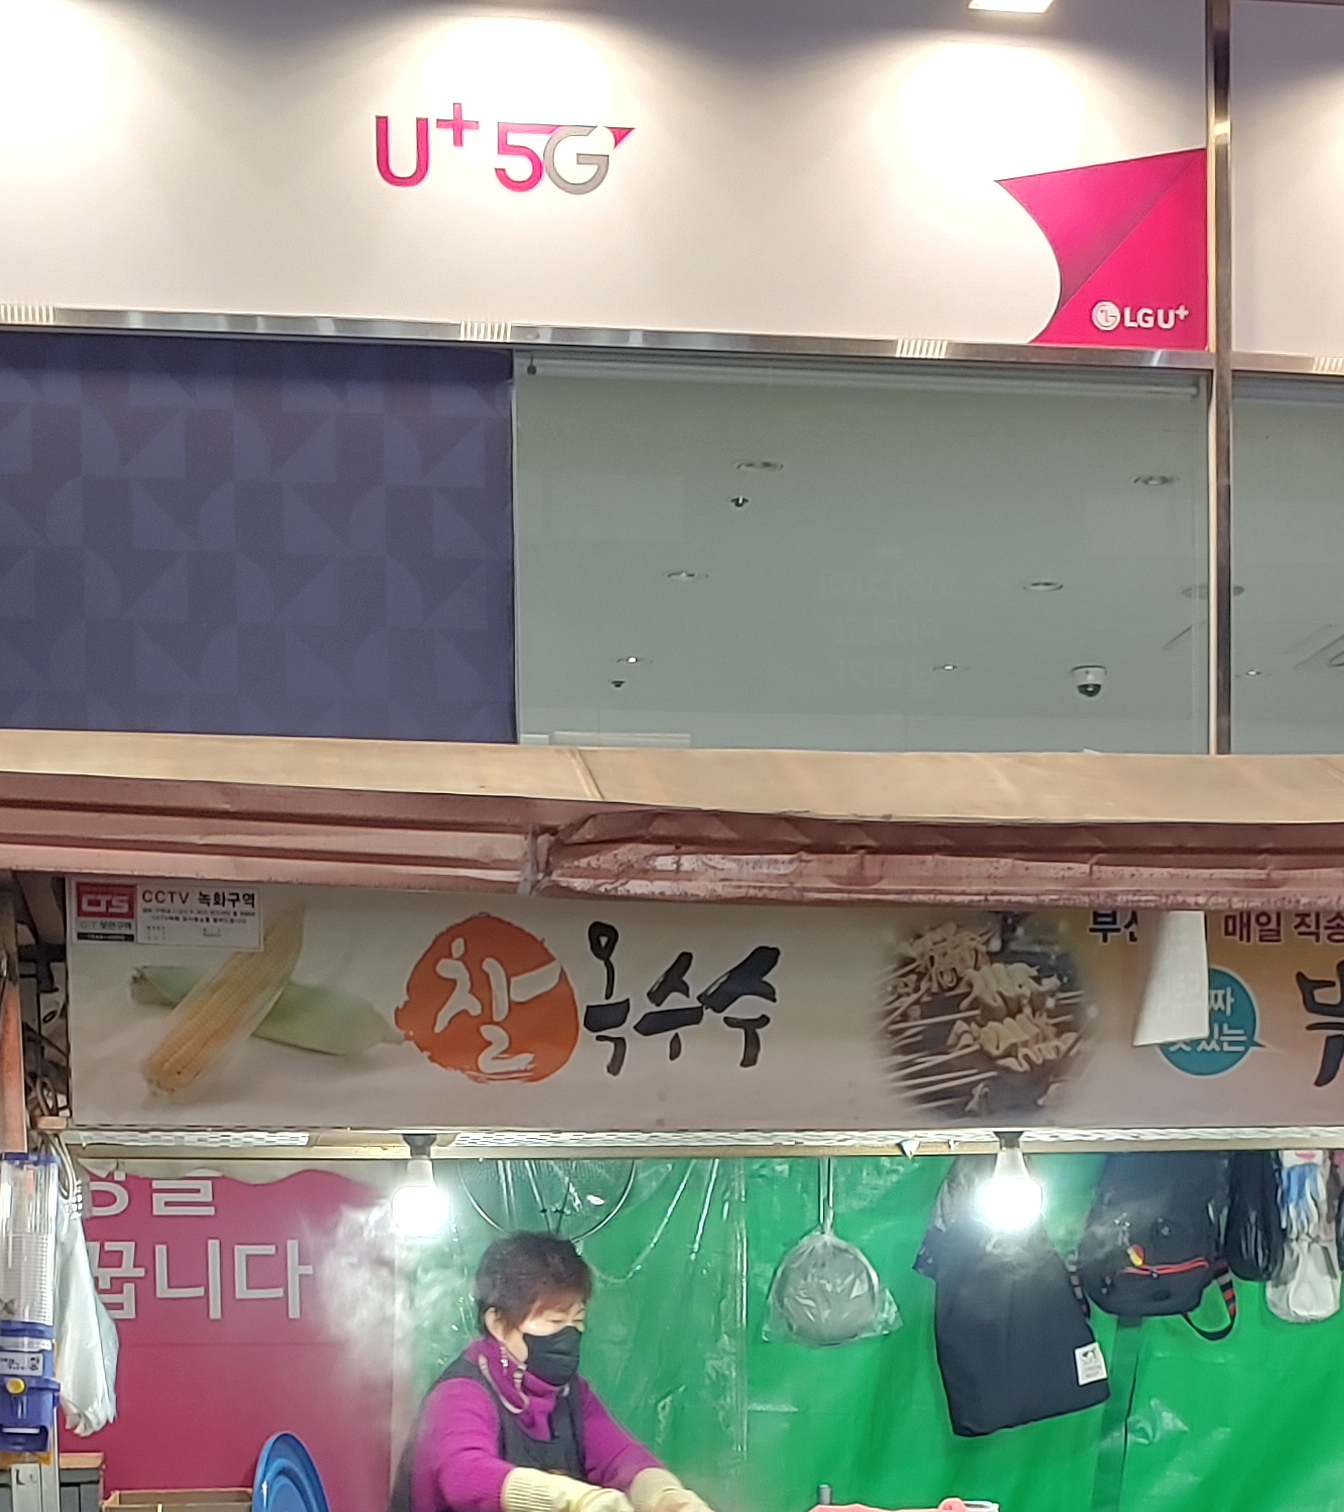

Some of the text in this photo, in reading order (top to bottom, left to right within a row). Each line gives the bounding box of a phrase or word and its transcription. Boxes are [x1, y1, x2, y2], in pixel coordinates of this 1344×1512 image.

[494, 121, 635, 195] 5G
[141, 889, 256, 909] CCTV 녹화구역
[1222, 910, 1283, 944] 매일
